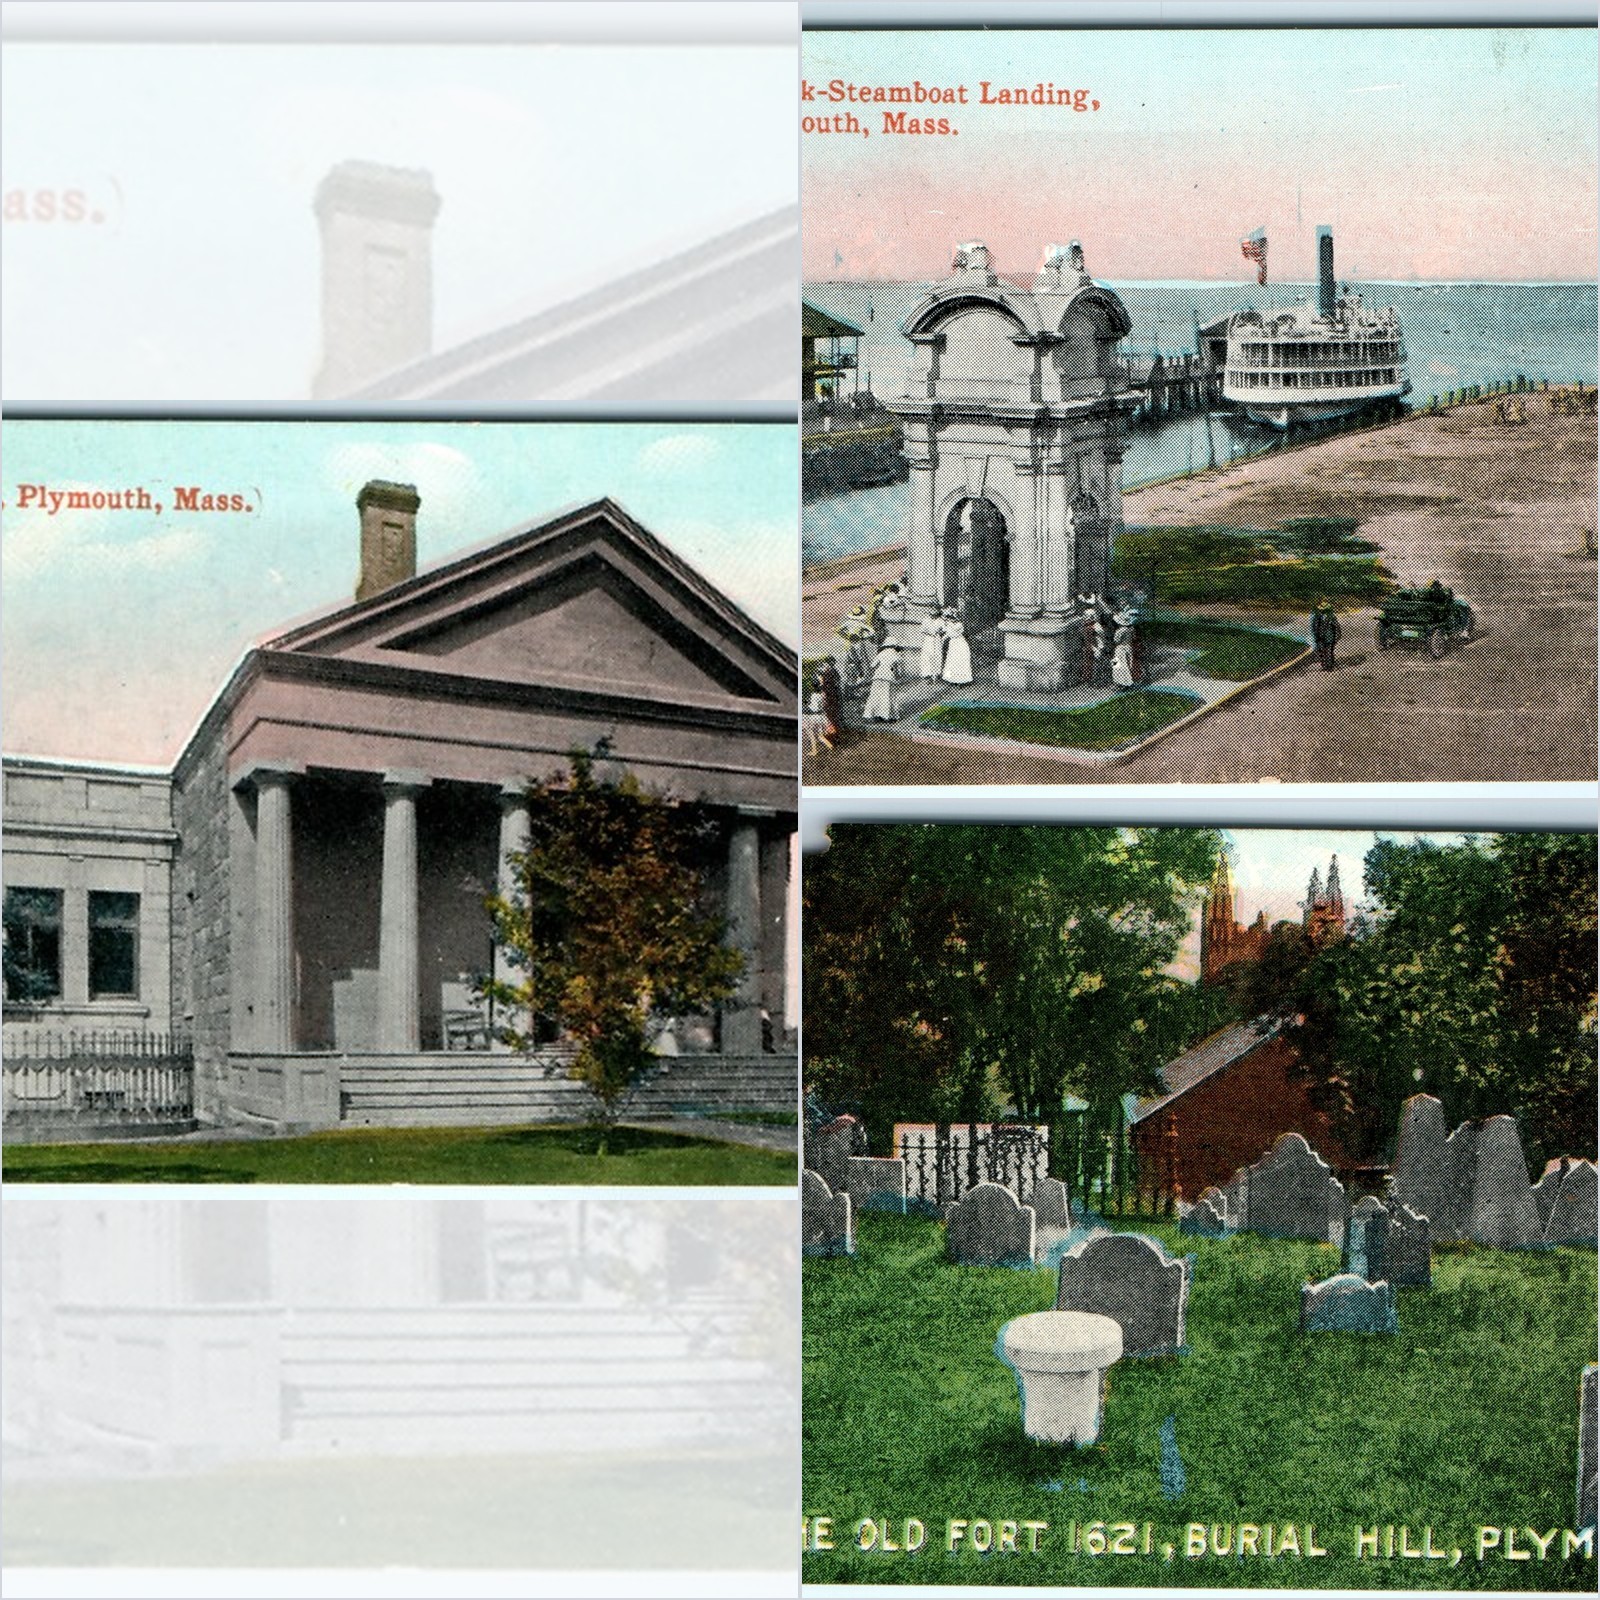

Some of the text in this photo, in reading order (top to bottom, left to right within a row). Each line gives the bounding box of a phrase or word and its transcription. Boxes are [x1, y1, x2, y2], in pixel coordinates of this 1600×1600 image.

[802, 79, 1100, 112] k-Steamboat Landing,
[802, 112, 959, 138] outh, Mass.
[17, 484, 163, 515] Plymouth,
[854, 1517, 927, 1552] OLD
[946, 1518, 1048, 1553] FORT
[1069, 1519, 1175, 1563] 1621,
[1186, 1521, 1328, 1559] BURIAL
[1354, 1524, 1463, 1567] HILL,
[1475, 1523, 1597, 1561] PLYM
